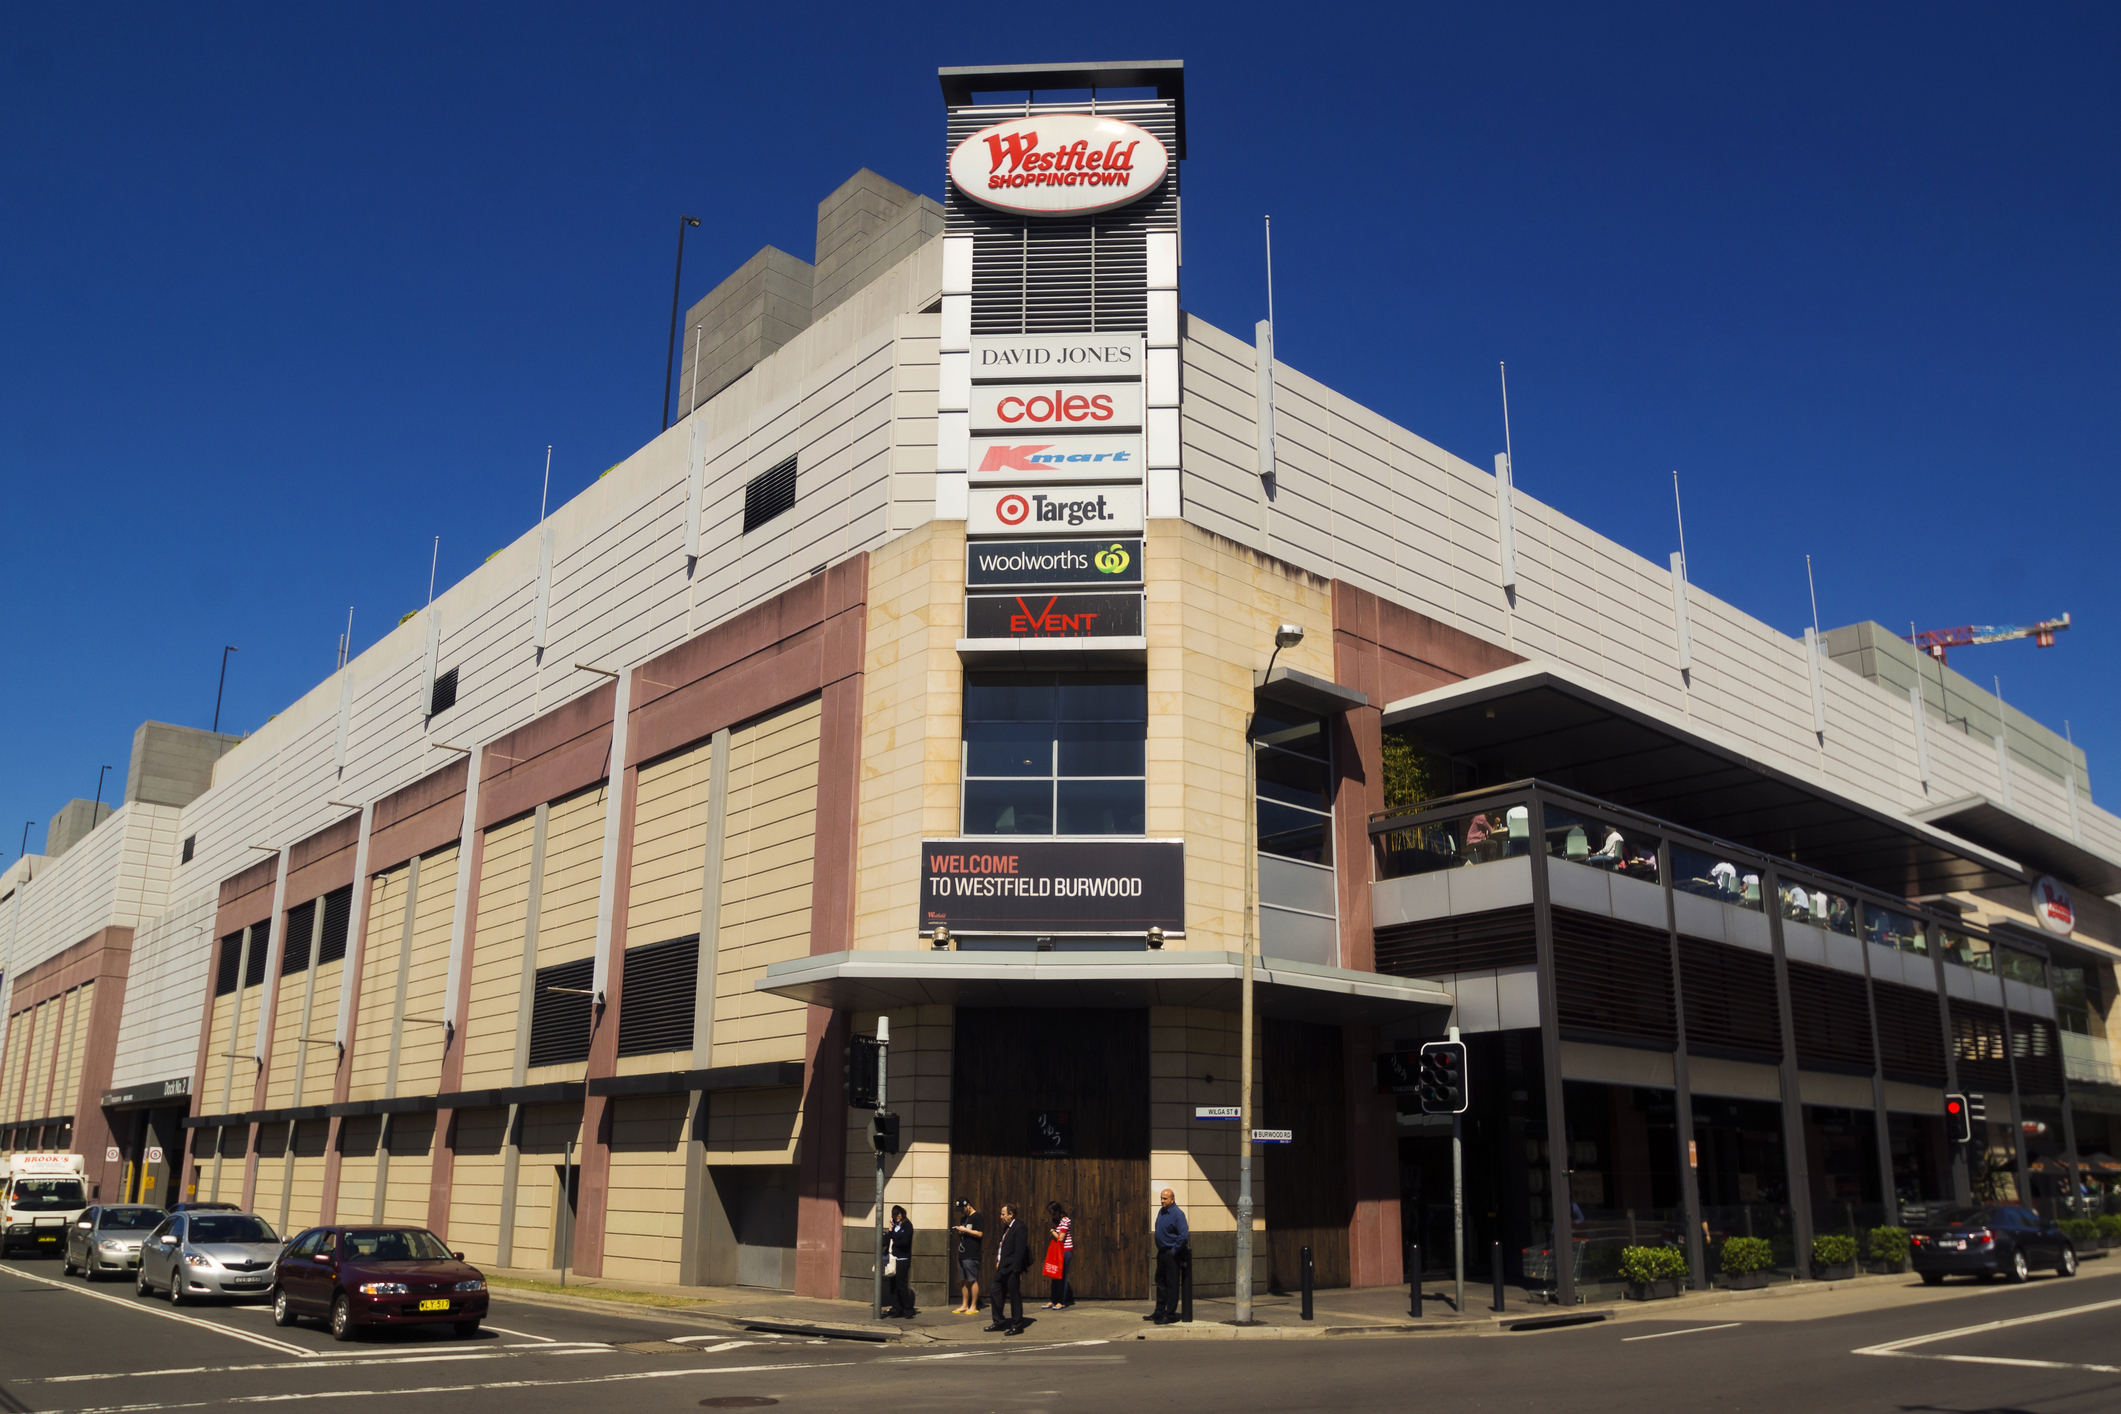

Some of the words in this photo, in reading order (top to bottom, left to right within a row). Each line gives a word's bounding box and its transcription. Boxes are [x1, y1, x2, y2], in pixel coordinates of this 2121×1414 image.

[983, 131, 1140, 173] Westfield
[988, 171, 1130, 188] SHOPPINGTOWN
[981, 348, 1051, 366] DAVID
[1057, 346, 1132, 364] JONES
[996, 389, 1114, 424] coles
[977, 444, 1131, 472] Kmart
[979, 550, 1088, 572] Woolworths
[1010, 596, 1098, 632] EVENT
[930, 855, 1019, 874] WELCOME
[930, 877, 951, 896] TO
[954, 877, 1051, 897] WESTFIELD
[1054, 877, 1142, 897] BURWOOD
